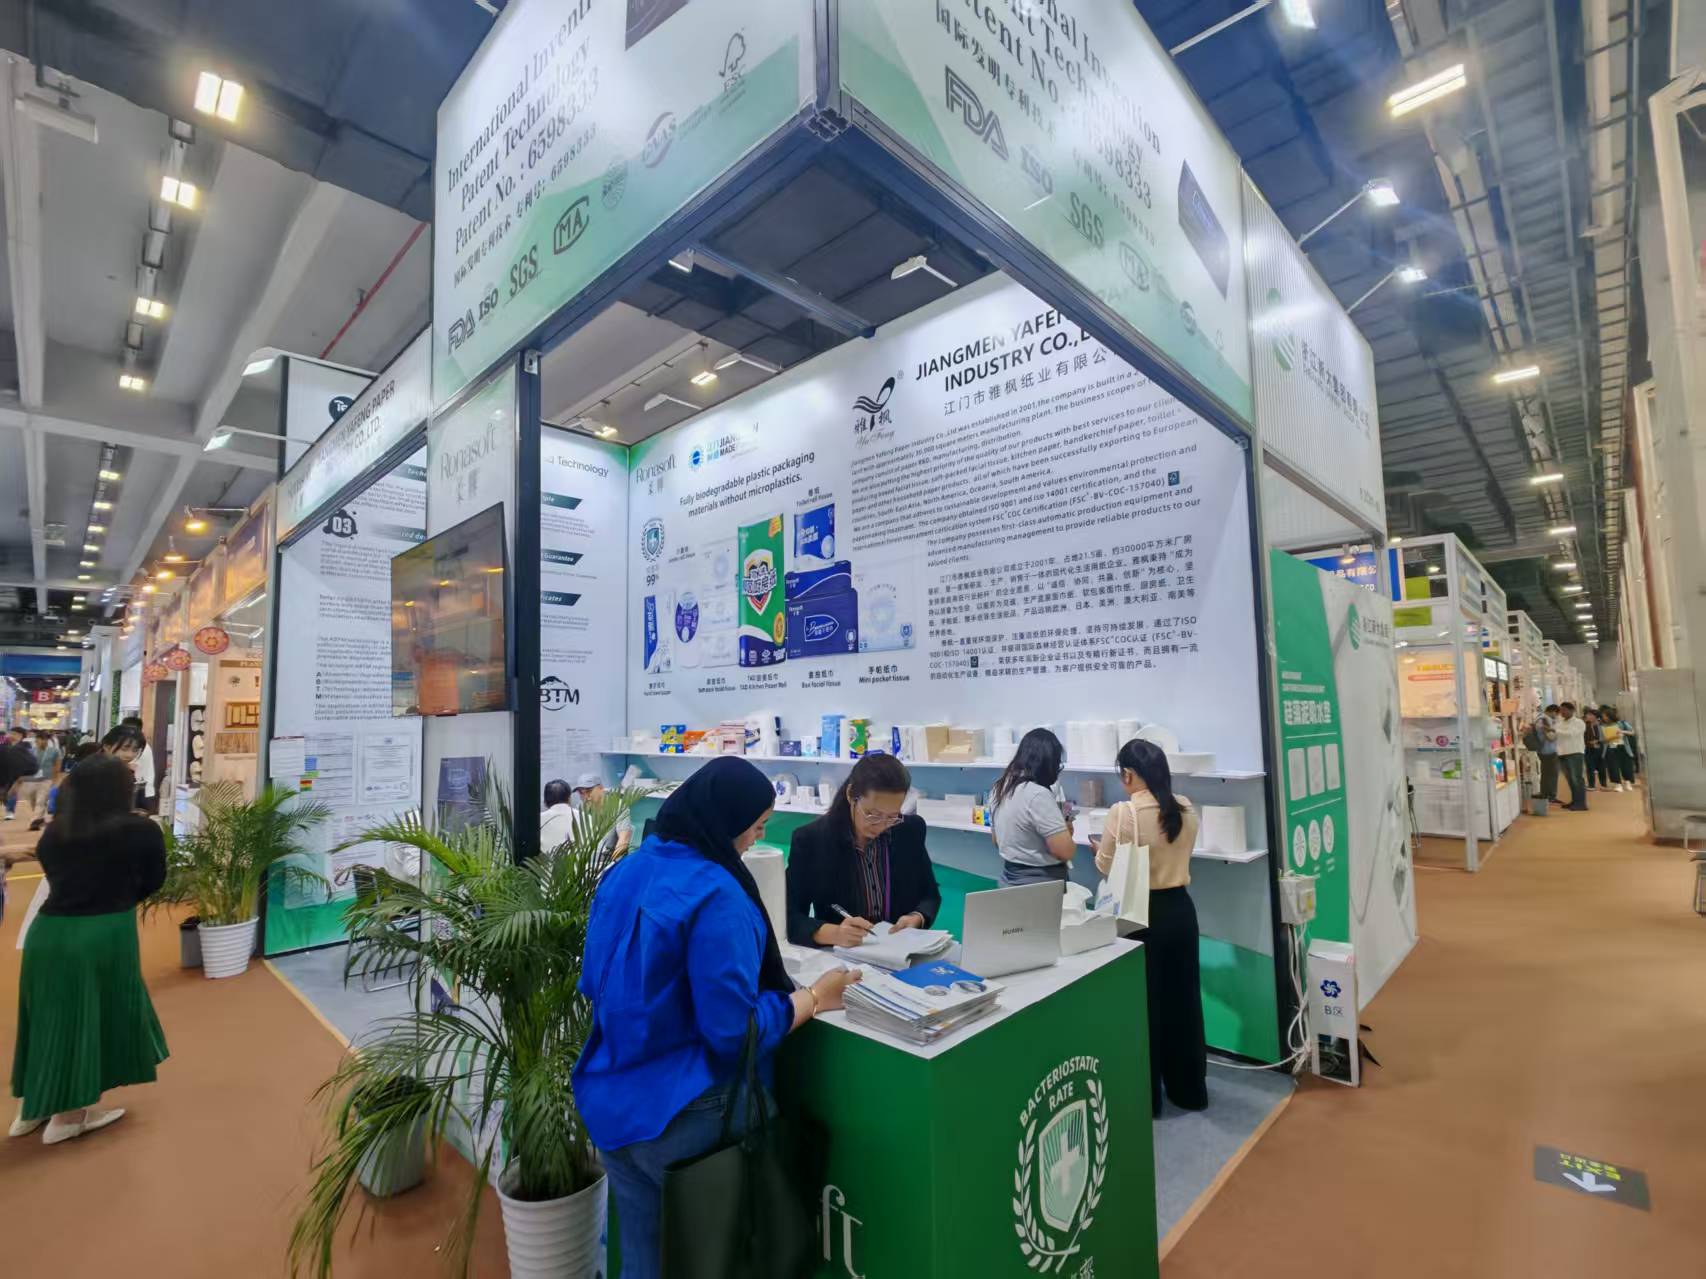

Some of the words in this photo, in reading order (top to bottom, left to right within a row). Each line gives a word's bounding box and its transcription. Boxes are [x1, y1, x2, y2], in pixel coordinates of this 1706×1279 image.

[448, 65, 529, 192] International
[462, 147, 499, 212] Patent
[503, 36, 591, 159] Technology
[456, 197, 492, 254] Patent
[528, 66, 599, 169] 6598333
[945, 64, 1009, 160] FDA
[1020, 145, 1054, 195] ISO
[1070, 191, 1104, 249] SGS
[448, 308, 476, 356] FDA
[479, 287, 499, 321] ISO
[509, 244, 539, 297] SGS
[916, 332, 1004, 381] JIANGMEN
[944, 346, 1119, 416] 江门市雅枫纸业有限公
[945, 344, 1035, 392] INDUSTRY
[979, 413, 1031, 438] manufacturing
[1054, 400, 1069, 413] The
[1069, 389, 1105, 408] business
[1105, 381, 1136, 398] scopes
[1010, 405, 1018, 415] in
[1050, 384, 1086, 404] company
[1095, 372, 1117, 387] built
[1116, 369, 1125, 381] in
[440, 422, 497, 481] Ronasoft
[719, 443, 736, 457] MADE
[963, 453, 974, 463] the
[974, 446, 999, 461] quality
[1007, 441, 1020, 450] our
[1020, 429, 1053, 448] products
[1054, 424, 1071, 437] with
[1071, 418, 1090, 432] best
[1090, 408, 1125, 426] services
[1135, 402, 1152, 413] our
[990, 465, 1011, 478] which
[1011, 460, 1029, 472] have
[1029, 454, 1050, 467] been
[1049, 441, 1098, 464] successfully
[1098, 429, 1141, 451] exporting
[1152, 414, 1199, 436] European
[1010, 446, 1037, 461] kitchen
[1037, 440, 1063, 455] paper,
[1062, 423, 1117, 446] handkerchief
[1117, 417, 1147, 433] paper,
[557, 456, 609, 478] Technology
[679, 494, 696, 508] Fully
[695, 476, 745, 502] biodegradable
[746, 466, 772, 488] plastic
[772, 451, 815, 477] packaging
[943, 495, 980, 512] sustainable
[980, 484, 1026, 504] development
[1026, 480, 1042, 491] and
[1042, 474, 1068, 488] values
[1068, 459, 1129, 482] environmental
[1129, 446, 1177, 468] protection
[1177, 441, 1198, 455] and
[998, 474, 1020, 487] South
[1019, 465, 1054, 482] America.
[688, 498, 719, 518] materials
[719, 488, 749, 510] without
[748, 473, 803, 499] microplastics.
[928, 513, 958, 527] company
[958, 505, 987, 519] obtained
[999, 498, 1017, 509] 9001
[1018, 494, 1032, 505] and
[1032, 491, 1045, 502] iso
[1045, 486, 1068, 499] 14001
[1069, 473, 1122, 495] certification,
[1122, 469, 1141, 481] and
[1140, 465, 1157, 477] the
[967, 515, 991, 529] system
[1021, 498, 1068, 516] Certification
[1036, 508, 1076, 524] automatic
[1076, 499, 1123, 518] production
[1123, 488, 1174, 508] equipment
[1174, 483, 1193, 496] and
[332, 516, 352, 533] 03
[956, 535, 1006, 553] manufacturing
[1006, 525, 1055, 544] management
[1064, 517, 1096, 532] provide
[1096, 510, 1130, 525] reliable
[1130, 502, 1171, 520] products
[1183, 498, 1202, 508] our
[859, 676, 871, 684] Mini
[871, 675, 892, 684] pocket
[892, 674, 910, 682] tissue
[1020, 1055, 1100, 1127] BACTERIOSTATIC
[1049, 1081, 1075, 1113] RATE
